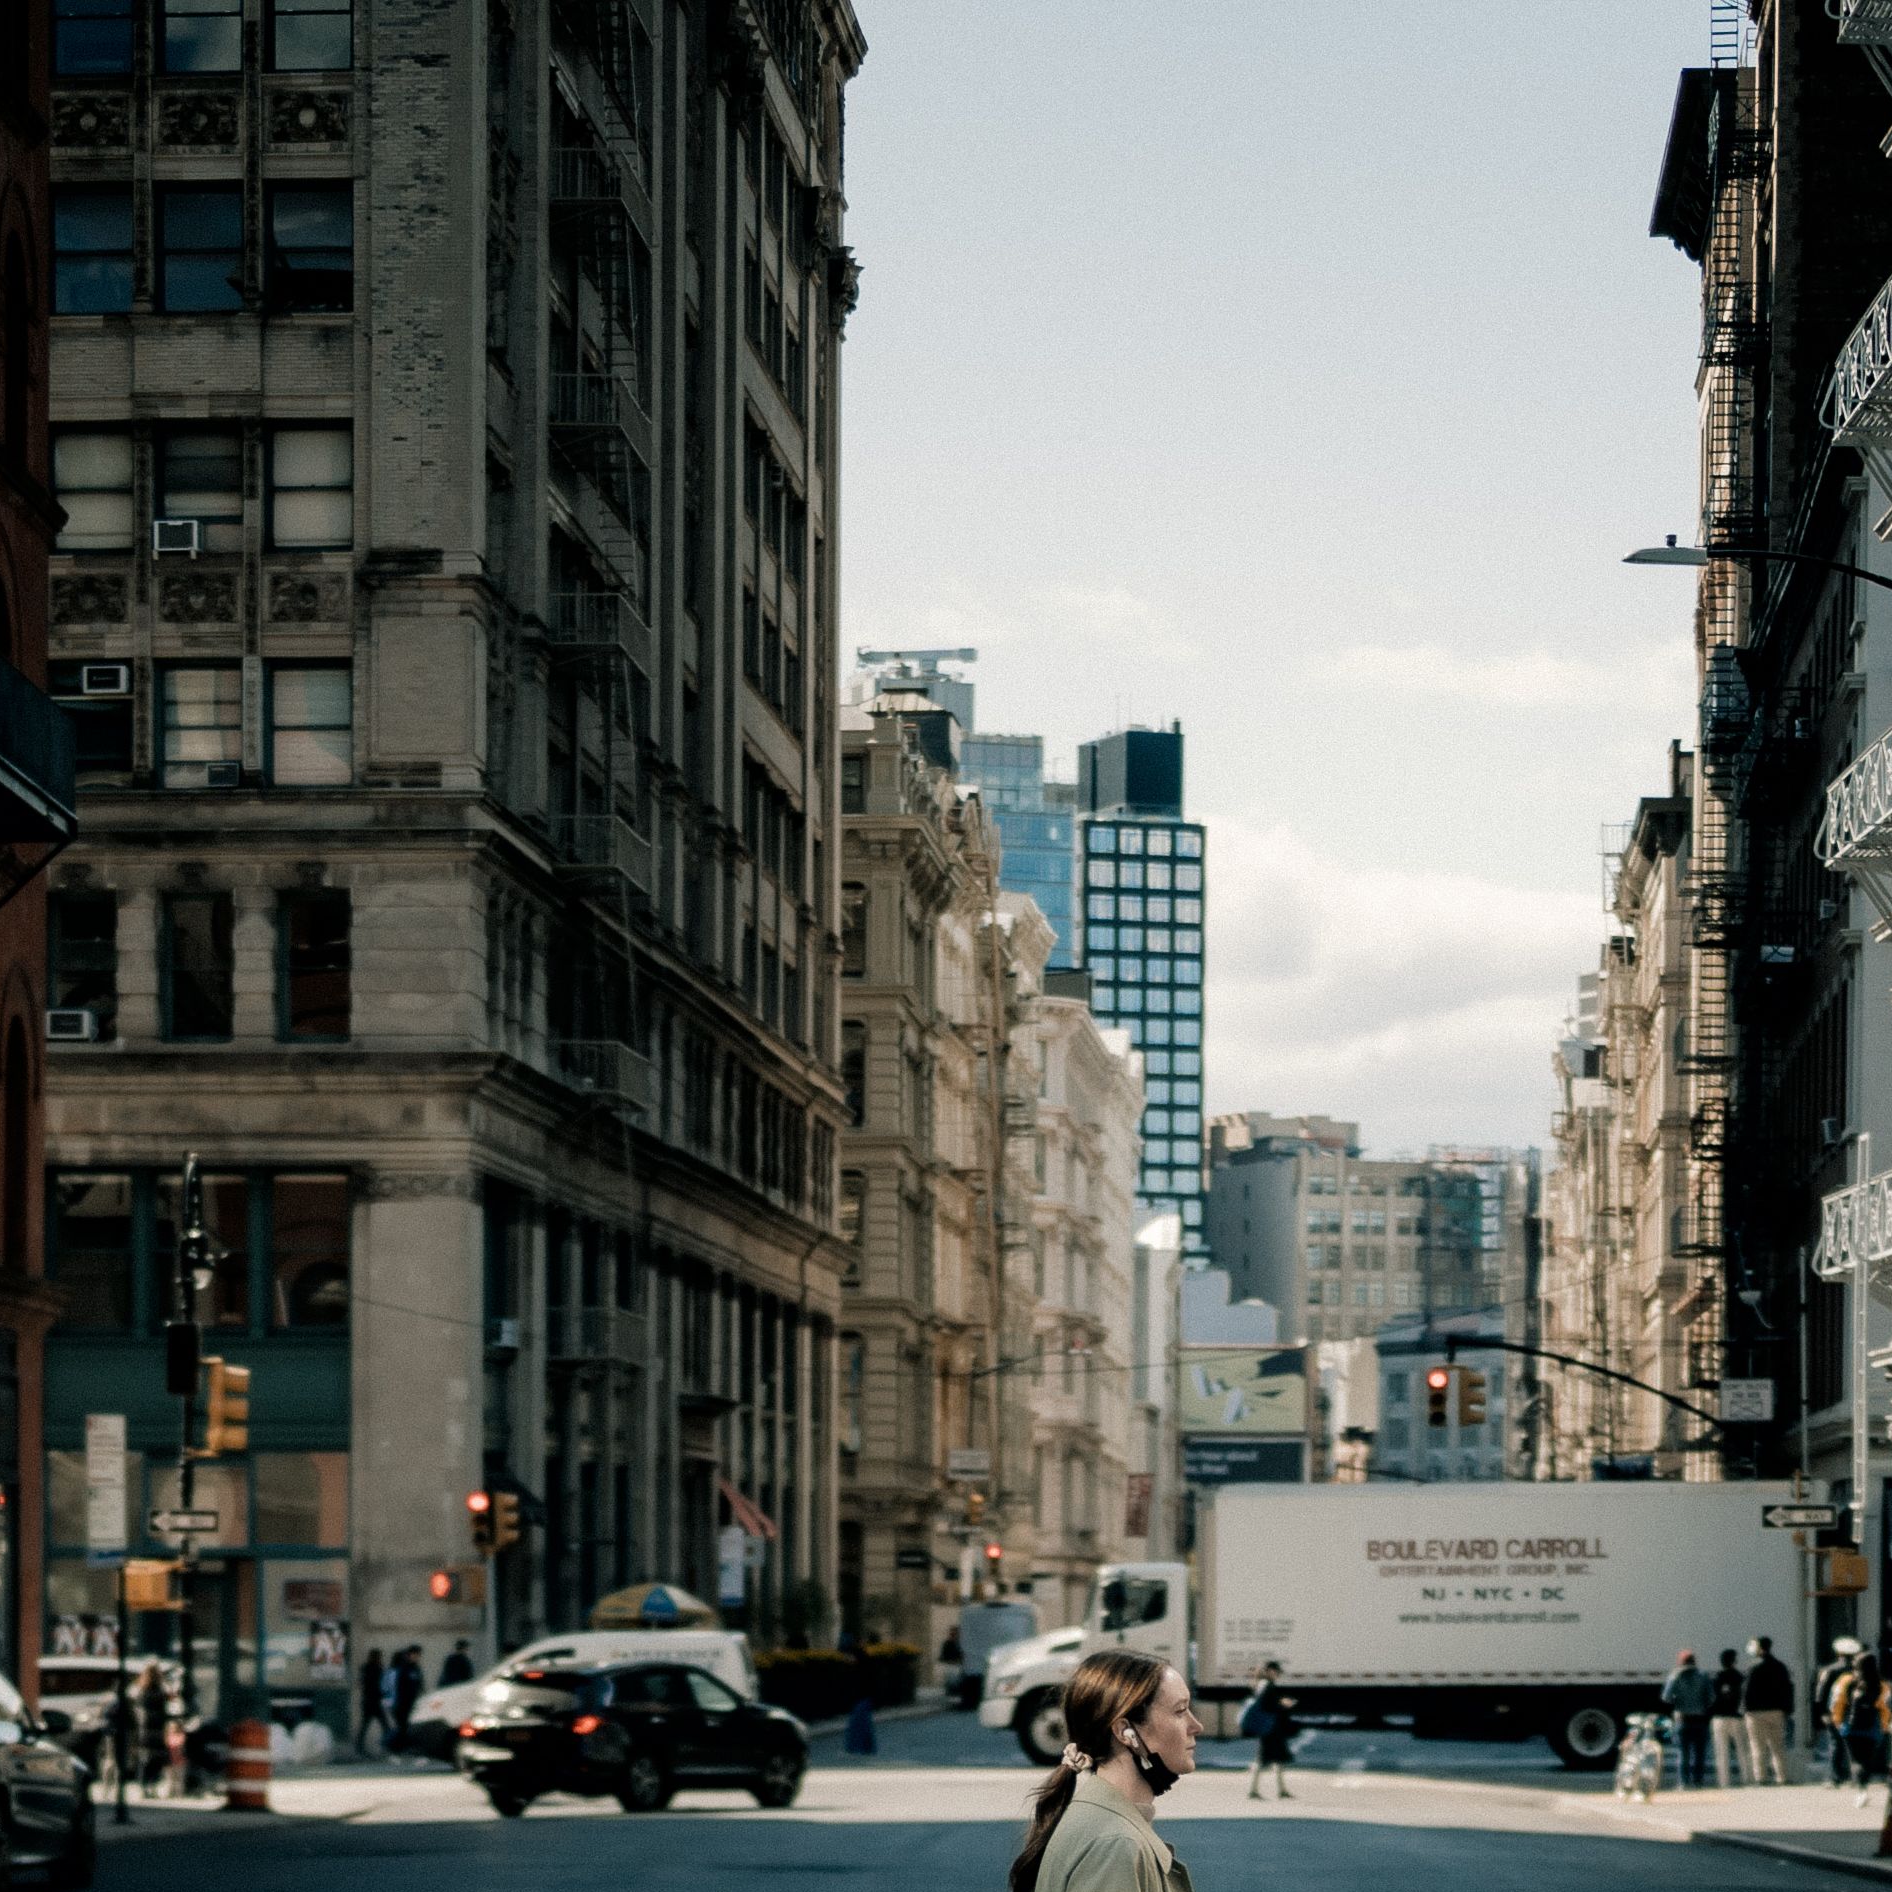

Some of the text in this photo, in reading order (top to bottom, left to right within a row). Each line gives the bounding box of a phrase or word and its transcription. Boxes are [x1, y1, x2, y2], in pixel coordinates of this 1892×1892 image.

[1367, 1537, 1608, 1561] BOULEVARD CARROLL
[1422, 1587, 1565, 1601] NJ NYC DC
